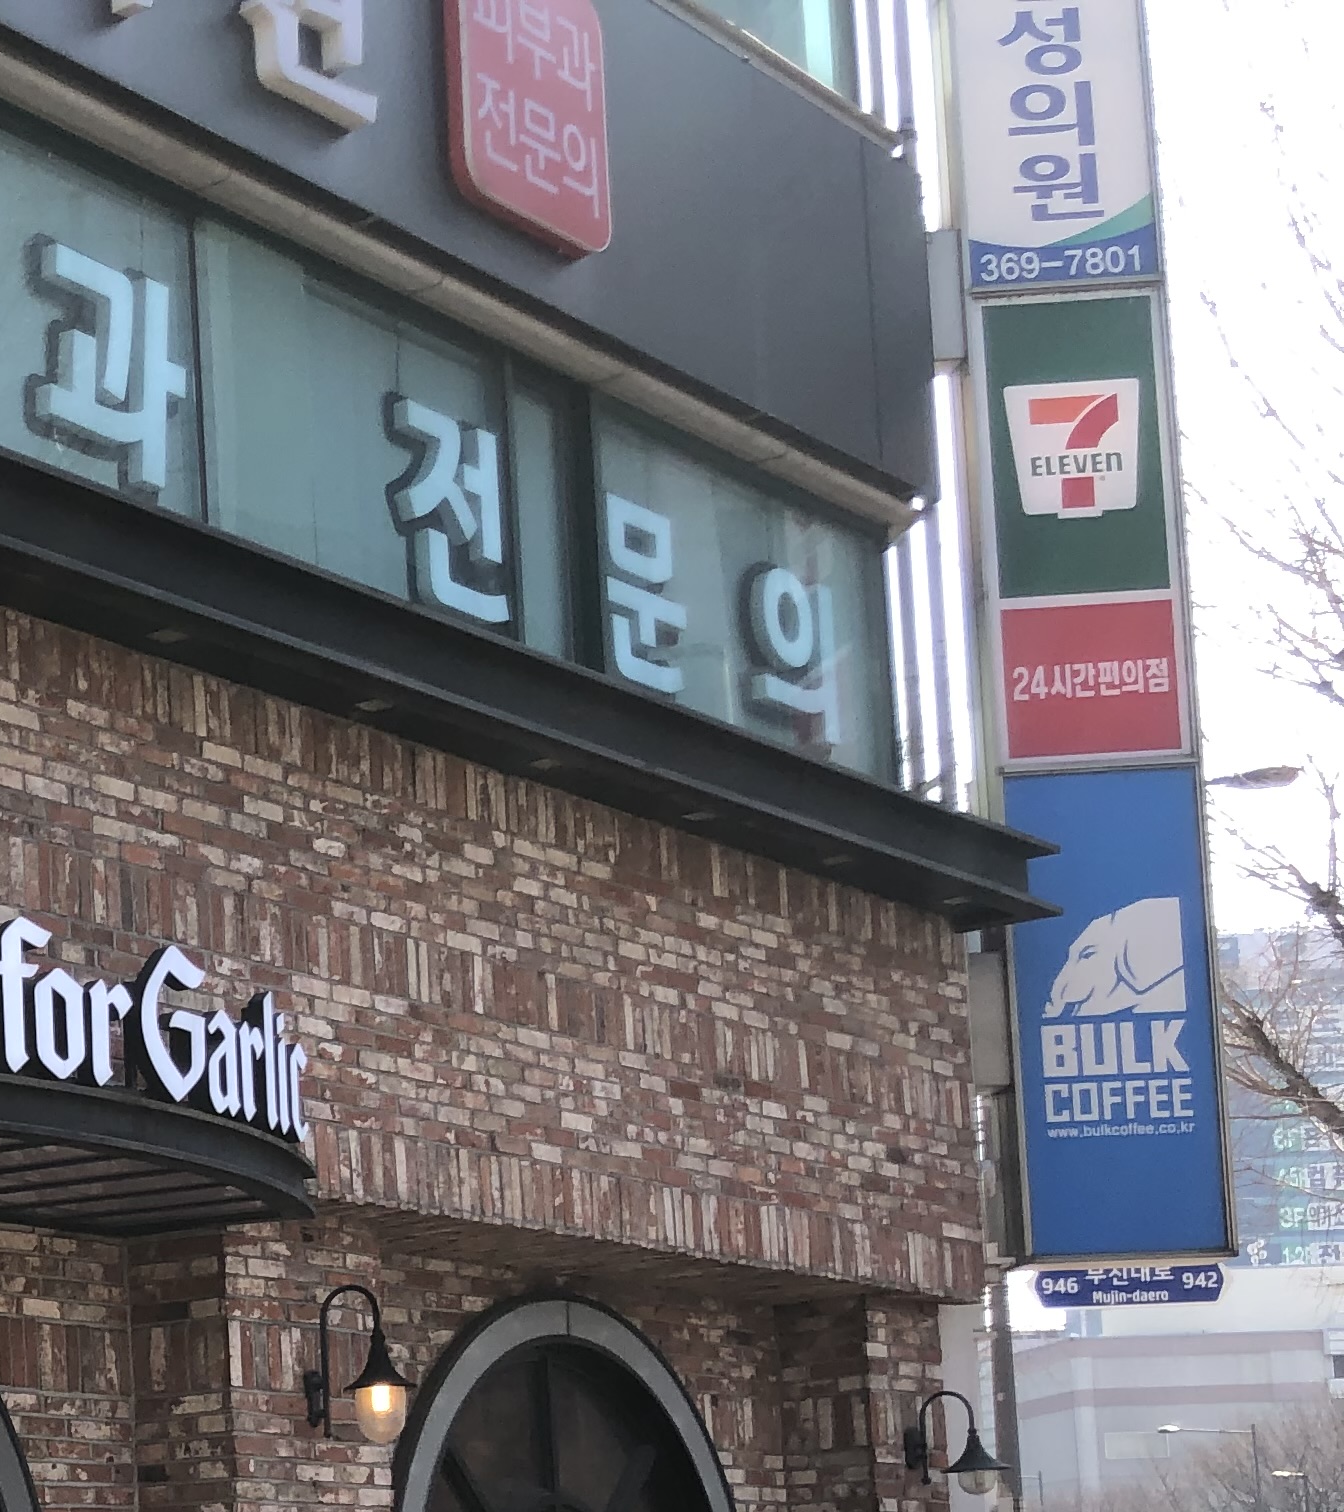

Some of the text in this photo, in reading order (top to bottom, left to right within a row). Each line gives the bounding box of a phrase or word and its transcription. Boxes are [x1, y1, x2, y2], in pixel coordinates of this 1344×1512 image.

[997, 6, 1105, 223] 성의원
[477, 72, 600, 220] 전문의
[979, 244, 1144, 283] 369-7801
[391, 400, 839, 746] 전문의
[1012, 656, 1171, 701] 24시간편의점
[140, 944, 309, 1143] Garlic
[1040, 1019, 1191, 1079] BULK
[1044, 1077, 1195, 1123] COFFEE
[1041, 1277, 1079, 1295] 946
[1181, 1271, 1219, 1290] 942
[1091, 1289, 1169, 1305] Mujin-daero
